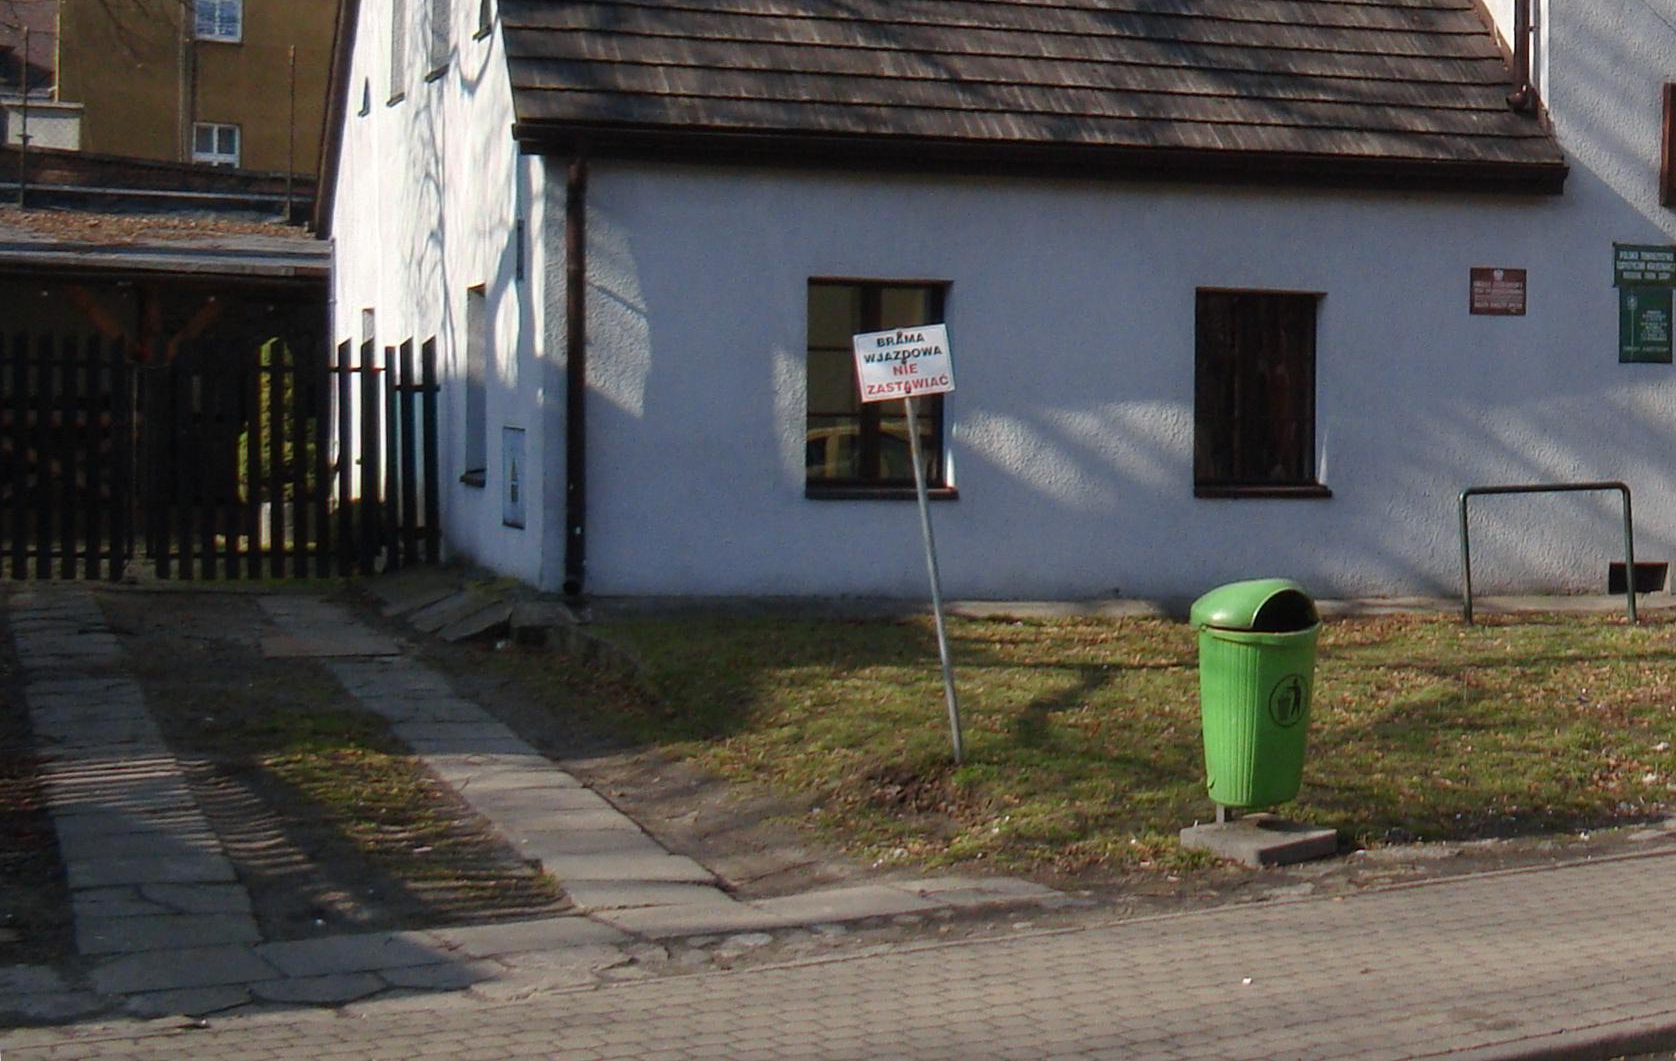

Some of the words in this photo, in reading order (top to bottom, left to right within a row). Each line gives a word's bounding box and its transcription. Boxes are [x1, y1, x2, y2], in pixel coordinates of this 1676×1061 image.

[876, 333, 926, 348] BRAMA
[863, 346, 943, 364] WJAZDOWA
[892, 363, 918, 376] NIE
[866, 373, 949, 395] ZASTAWIAĆ
